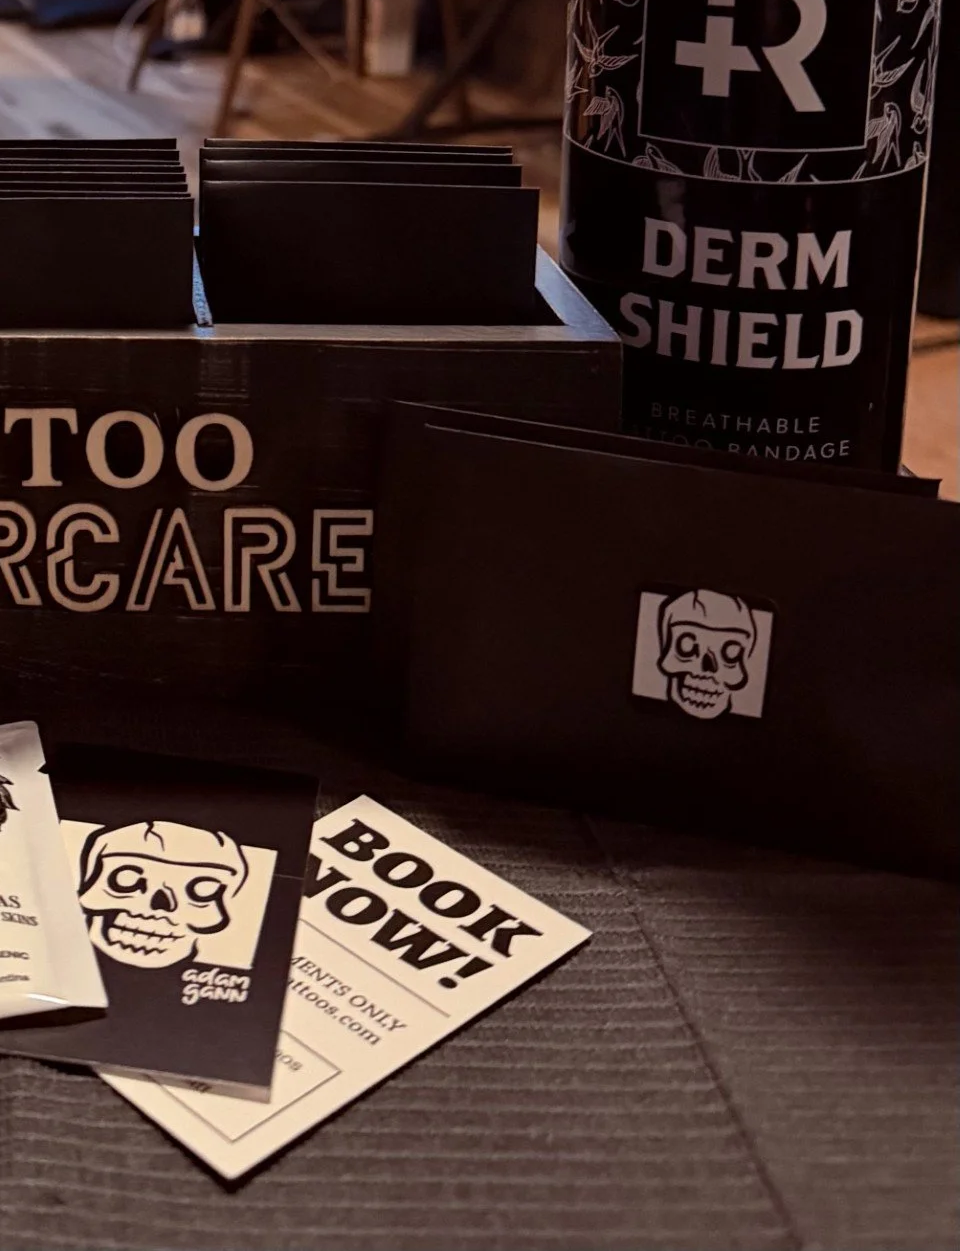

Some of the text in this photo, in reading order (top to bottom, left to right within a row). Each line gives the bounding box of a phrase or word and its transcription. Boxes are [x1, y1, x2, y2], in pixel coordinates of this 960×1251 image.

[642, 217, 852, 290] DERM
[620, 292, 864, 369] SHIELD
[651, 402, 822, 433] BREATHABLE
[319, 818, 544, 958] BOOK
[1, 911, 36, 924] SKINS
[349, 997, 405, 1030] ONLY
